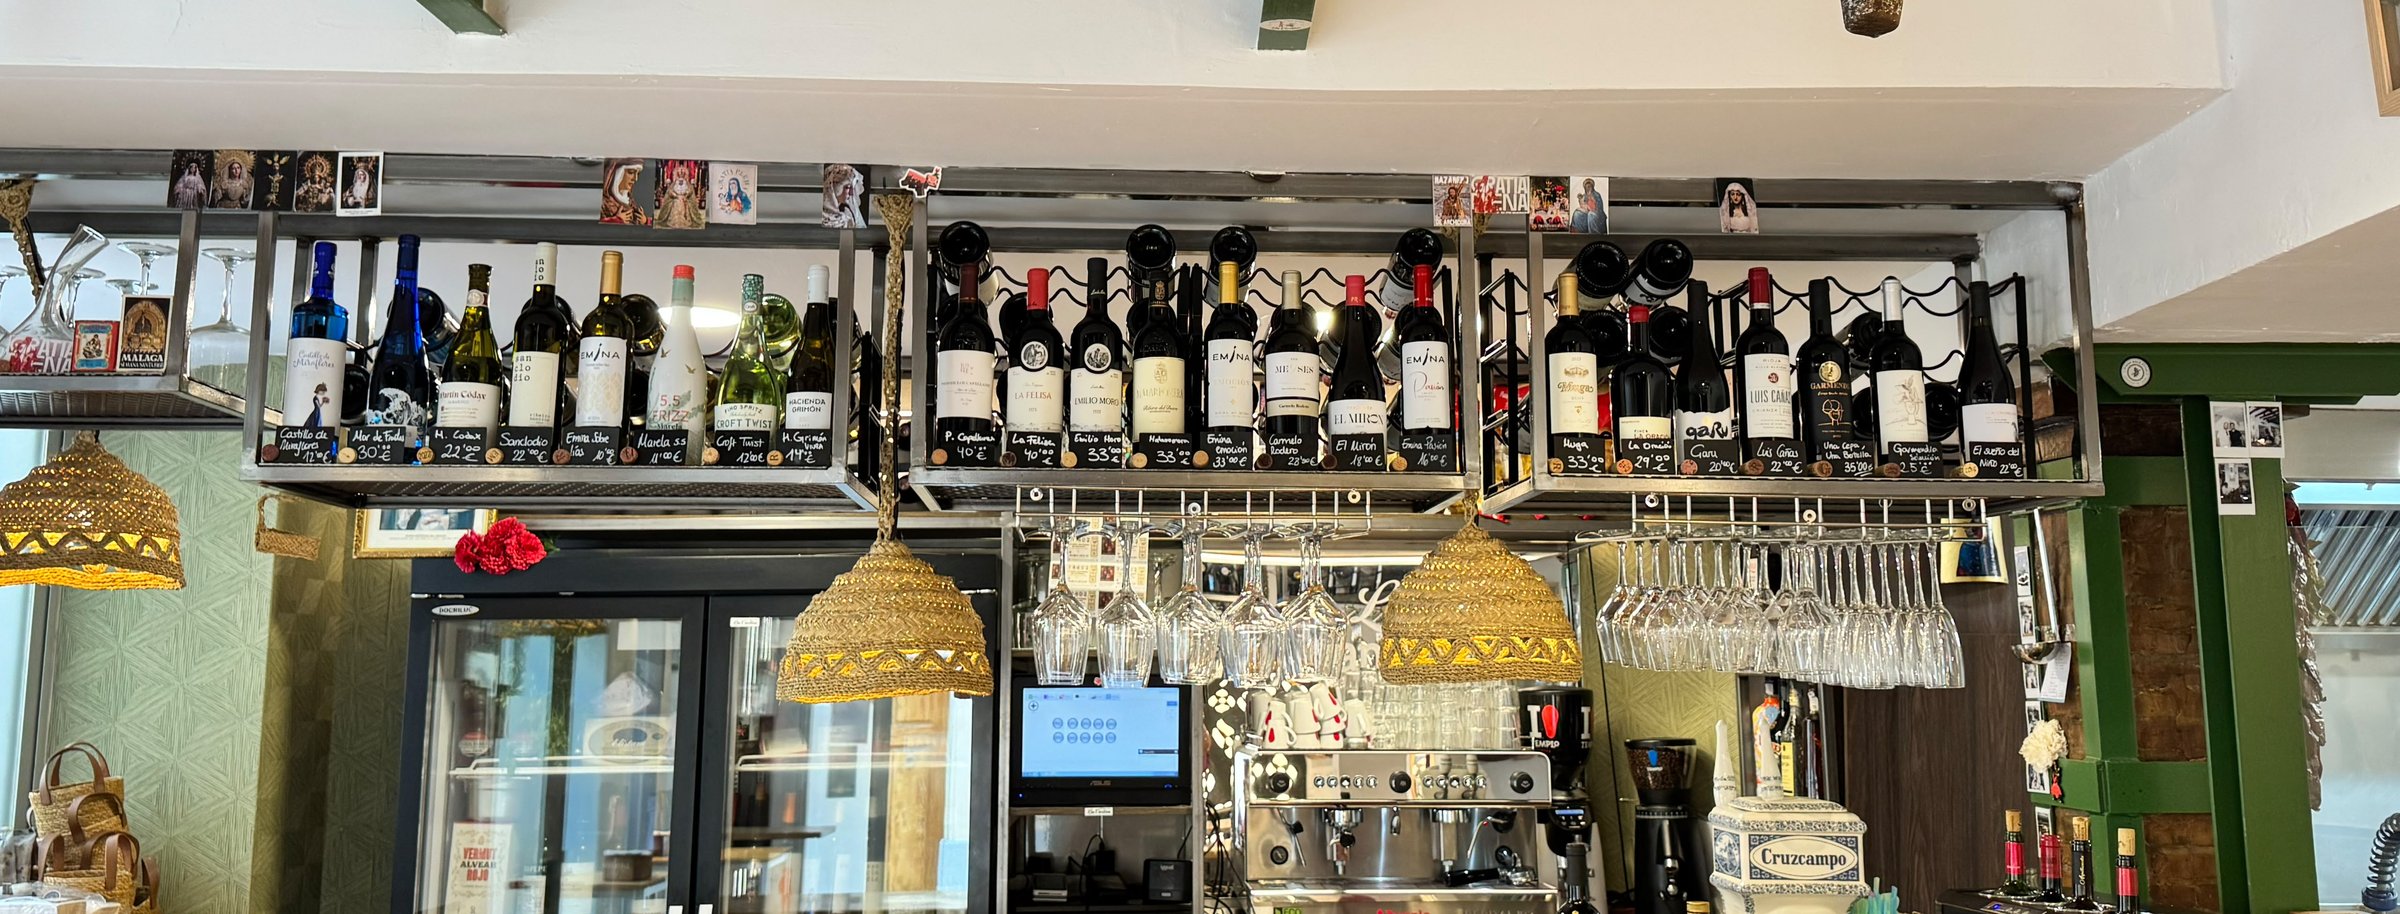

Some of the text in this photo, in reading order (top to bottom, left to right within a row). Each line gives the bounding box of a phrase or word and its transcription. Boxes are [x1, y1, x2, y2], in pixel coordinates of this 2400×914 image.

[293, 359, 335, 370] Miraflores
[660, 395, 681, 407] 5.5
[1014, 391, 1052, 400] LA FELISA
[1074, 396, 1119, 406] EMILIO MORO
[1750, 389, 1769, 404] LUIS
[789, 398, 826, 406] HACIENDA
[740, 404, 763, 414] SPRITZ
[792, 405, 822, 413] GRIMÓN
[652, 410, 689, 423] FRIZZ
[716, 418, 773, 429] CROFT TWIST
[280, 429, 328, 440] Castillo de
[373, 431, 383, 443] de
[500, 432, 549, 447] Sanclodio
[1012, 433, 1026, 444] La
[1074, 433, 1099, 443] Emilio
[1269, 434, 1303, 445] Carmelo
[1350, 437, 1377, 452] Mirón
[1628, 440, 1641, 450] La
[1757, 442, 1799, 458] Luis Cañas
[1824, 442, 1840, 450] Una
[1761, 848, 1847, 870] Cruzcampo
[467, 869, 489, 881] ROJO
